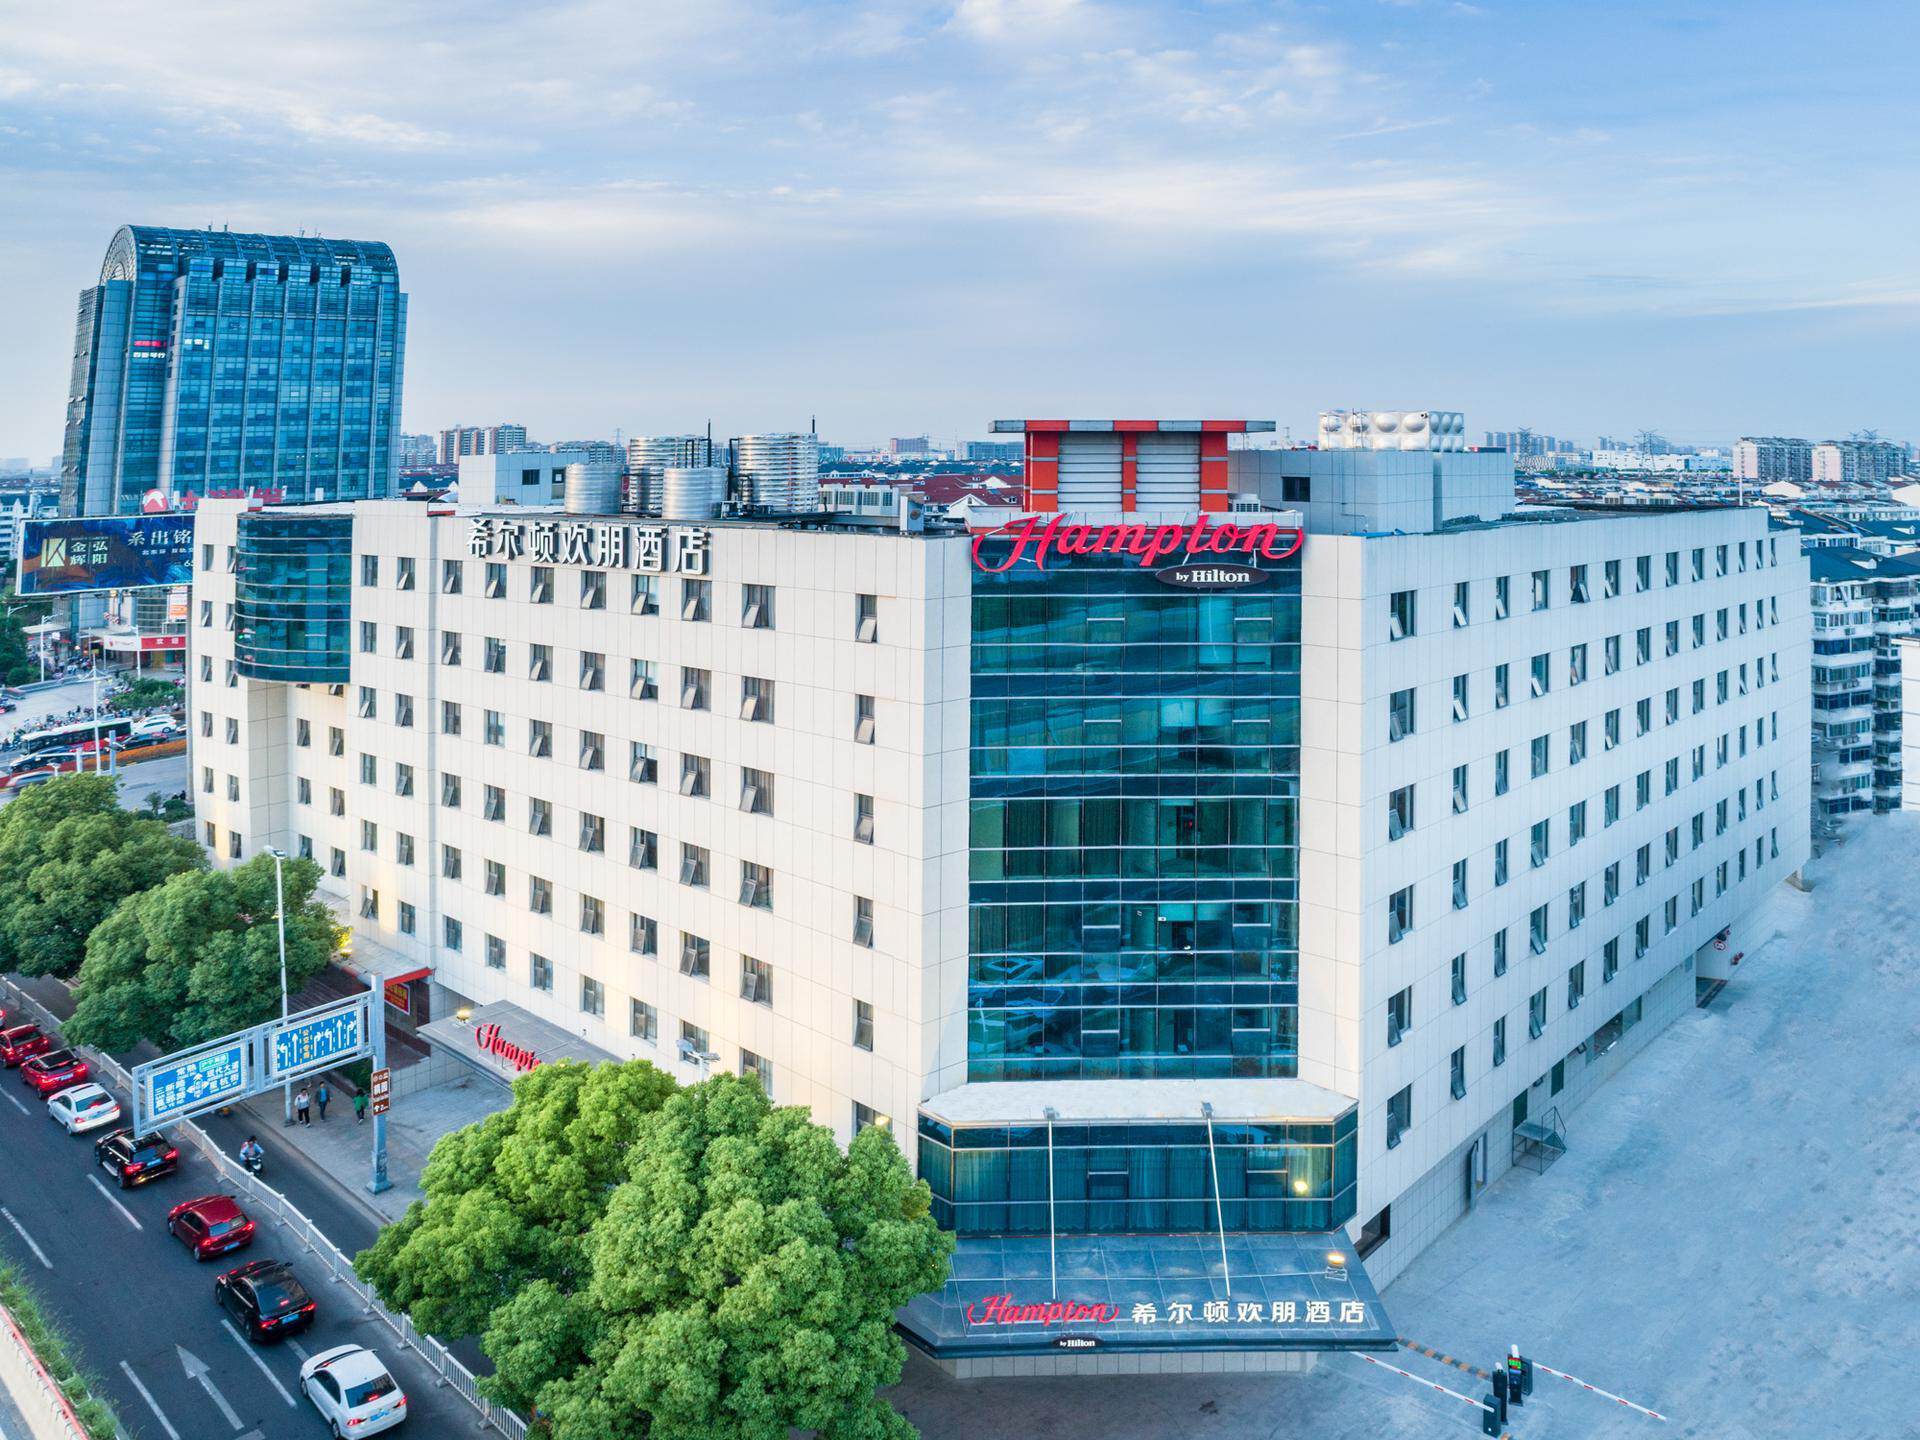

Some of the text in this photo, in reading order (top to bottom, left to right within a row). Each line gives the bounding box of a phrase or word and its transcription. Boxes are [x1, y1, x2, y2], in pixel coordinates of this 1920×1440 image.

[466, 518, 706, 575] 希尔顿欢朋酒店
[972, 513, 1305, 573] Hampton
[1176, 569, 1250, 583] by Hilton
[475, 1023, 541, 1073] Hampto
[967, 1292, 1119, 1327] Hampton
[1131, 1300, 1365, 1325] 希尔顿欢朋酒店
[1067, 1339, 1096, 1347] Hilton
